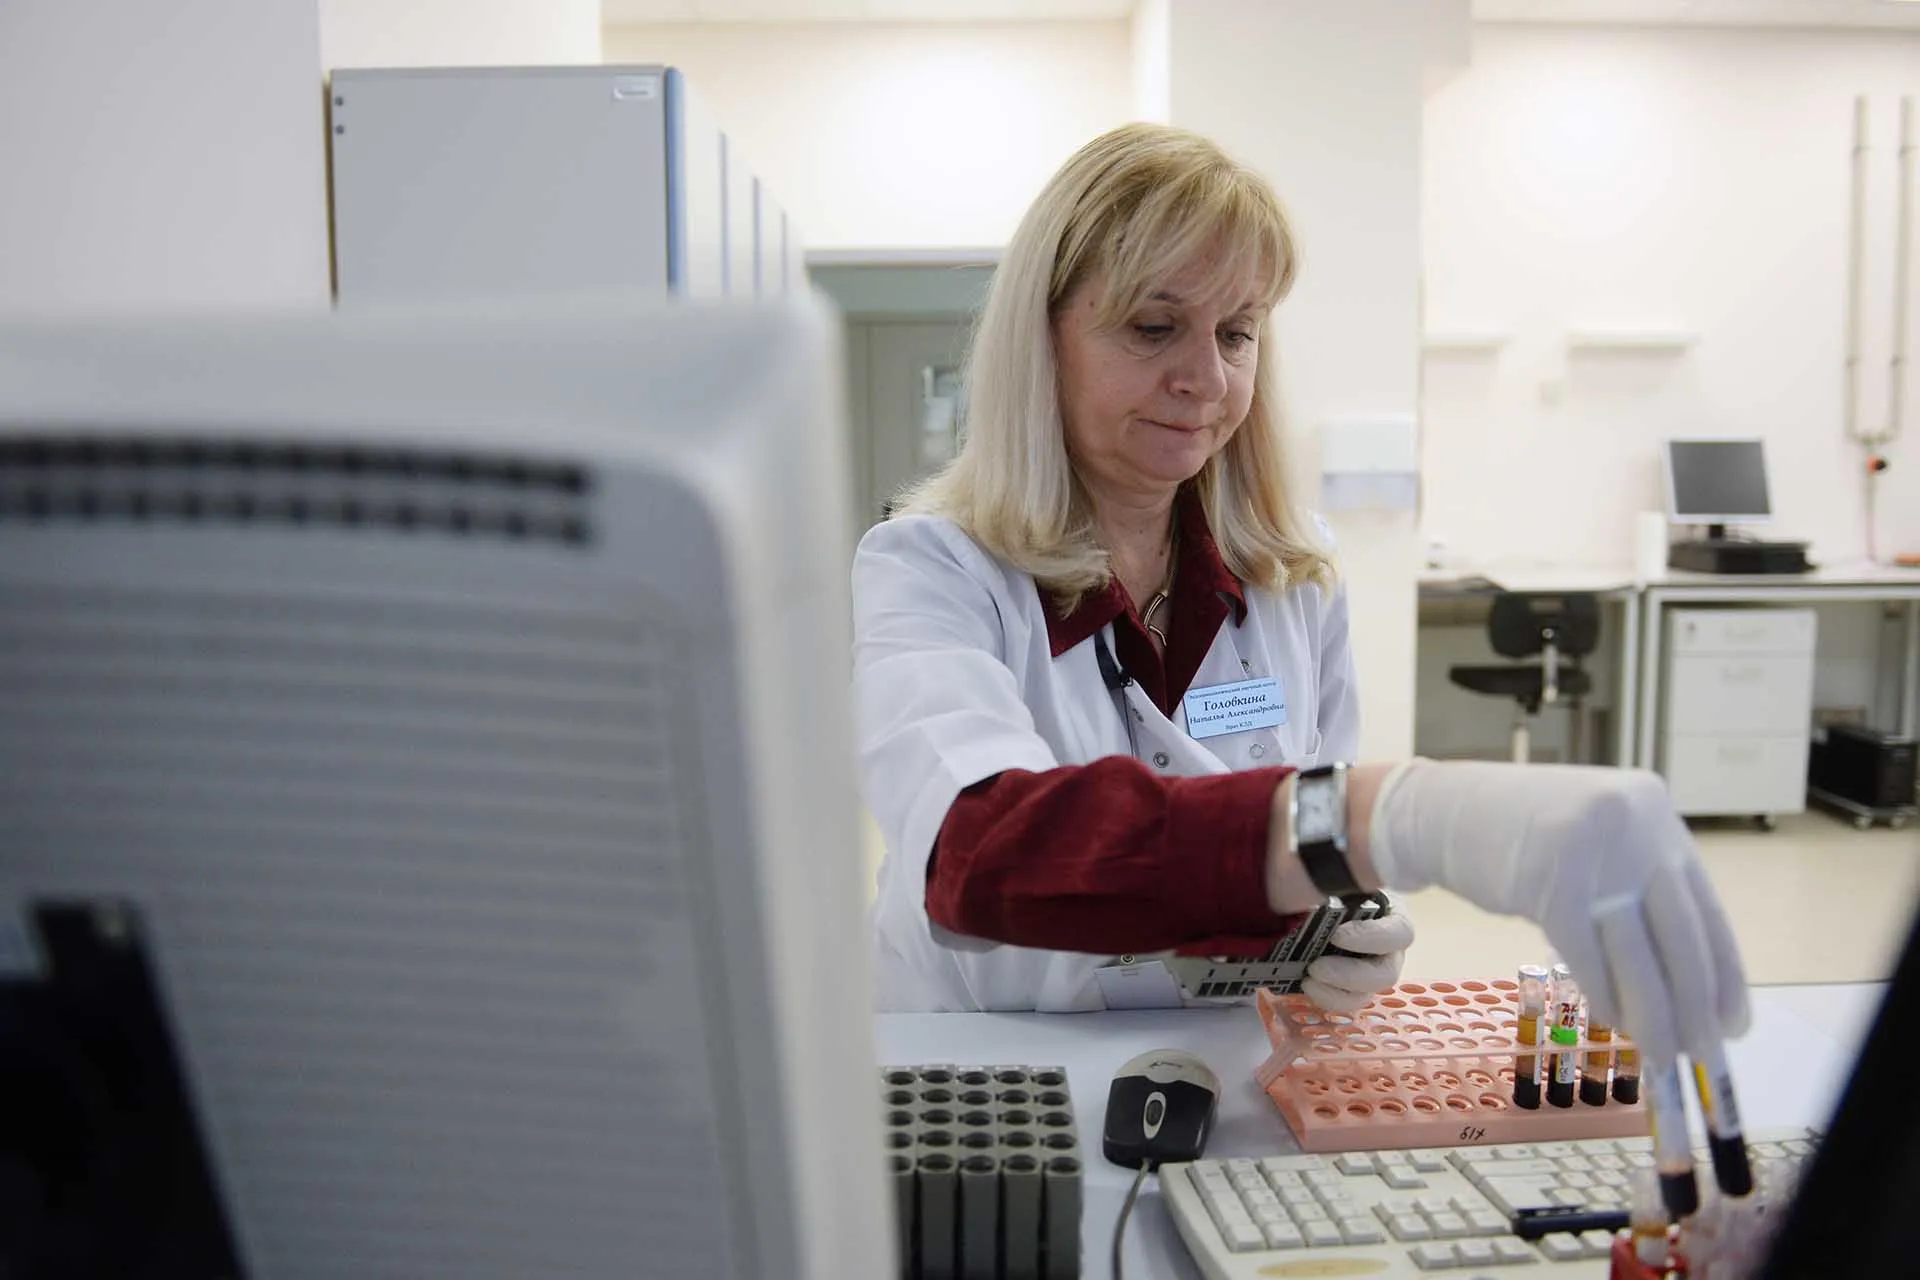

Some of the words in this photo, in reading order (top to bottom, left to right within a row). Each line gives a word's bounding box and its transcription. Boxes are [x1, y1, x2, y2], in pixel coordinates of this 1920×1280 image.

[1204, 694, 1266, 711] Головкина
[1190, 713, 1225, 724] Наталья
[1227, 703, 1284, 719] Александровна
